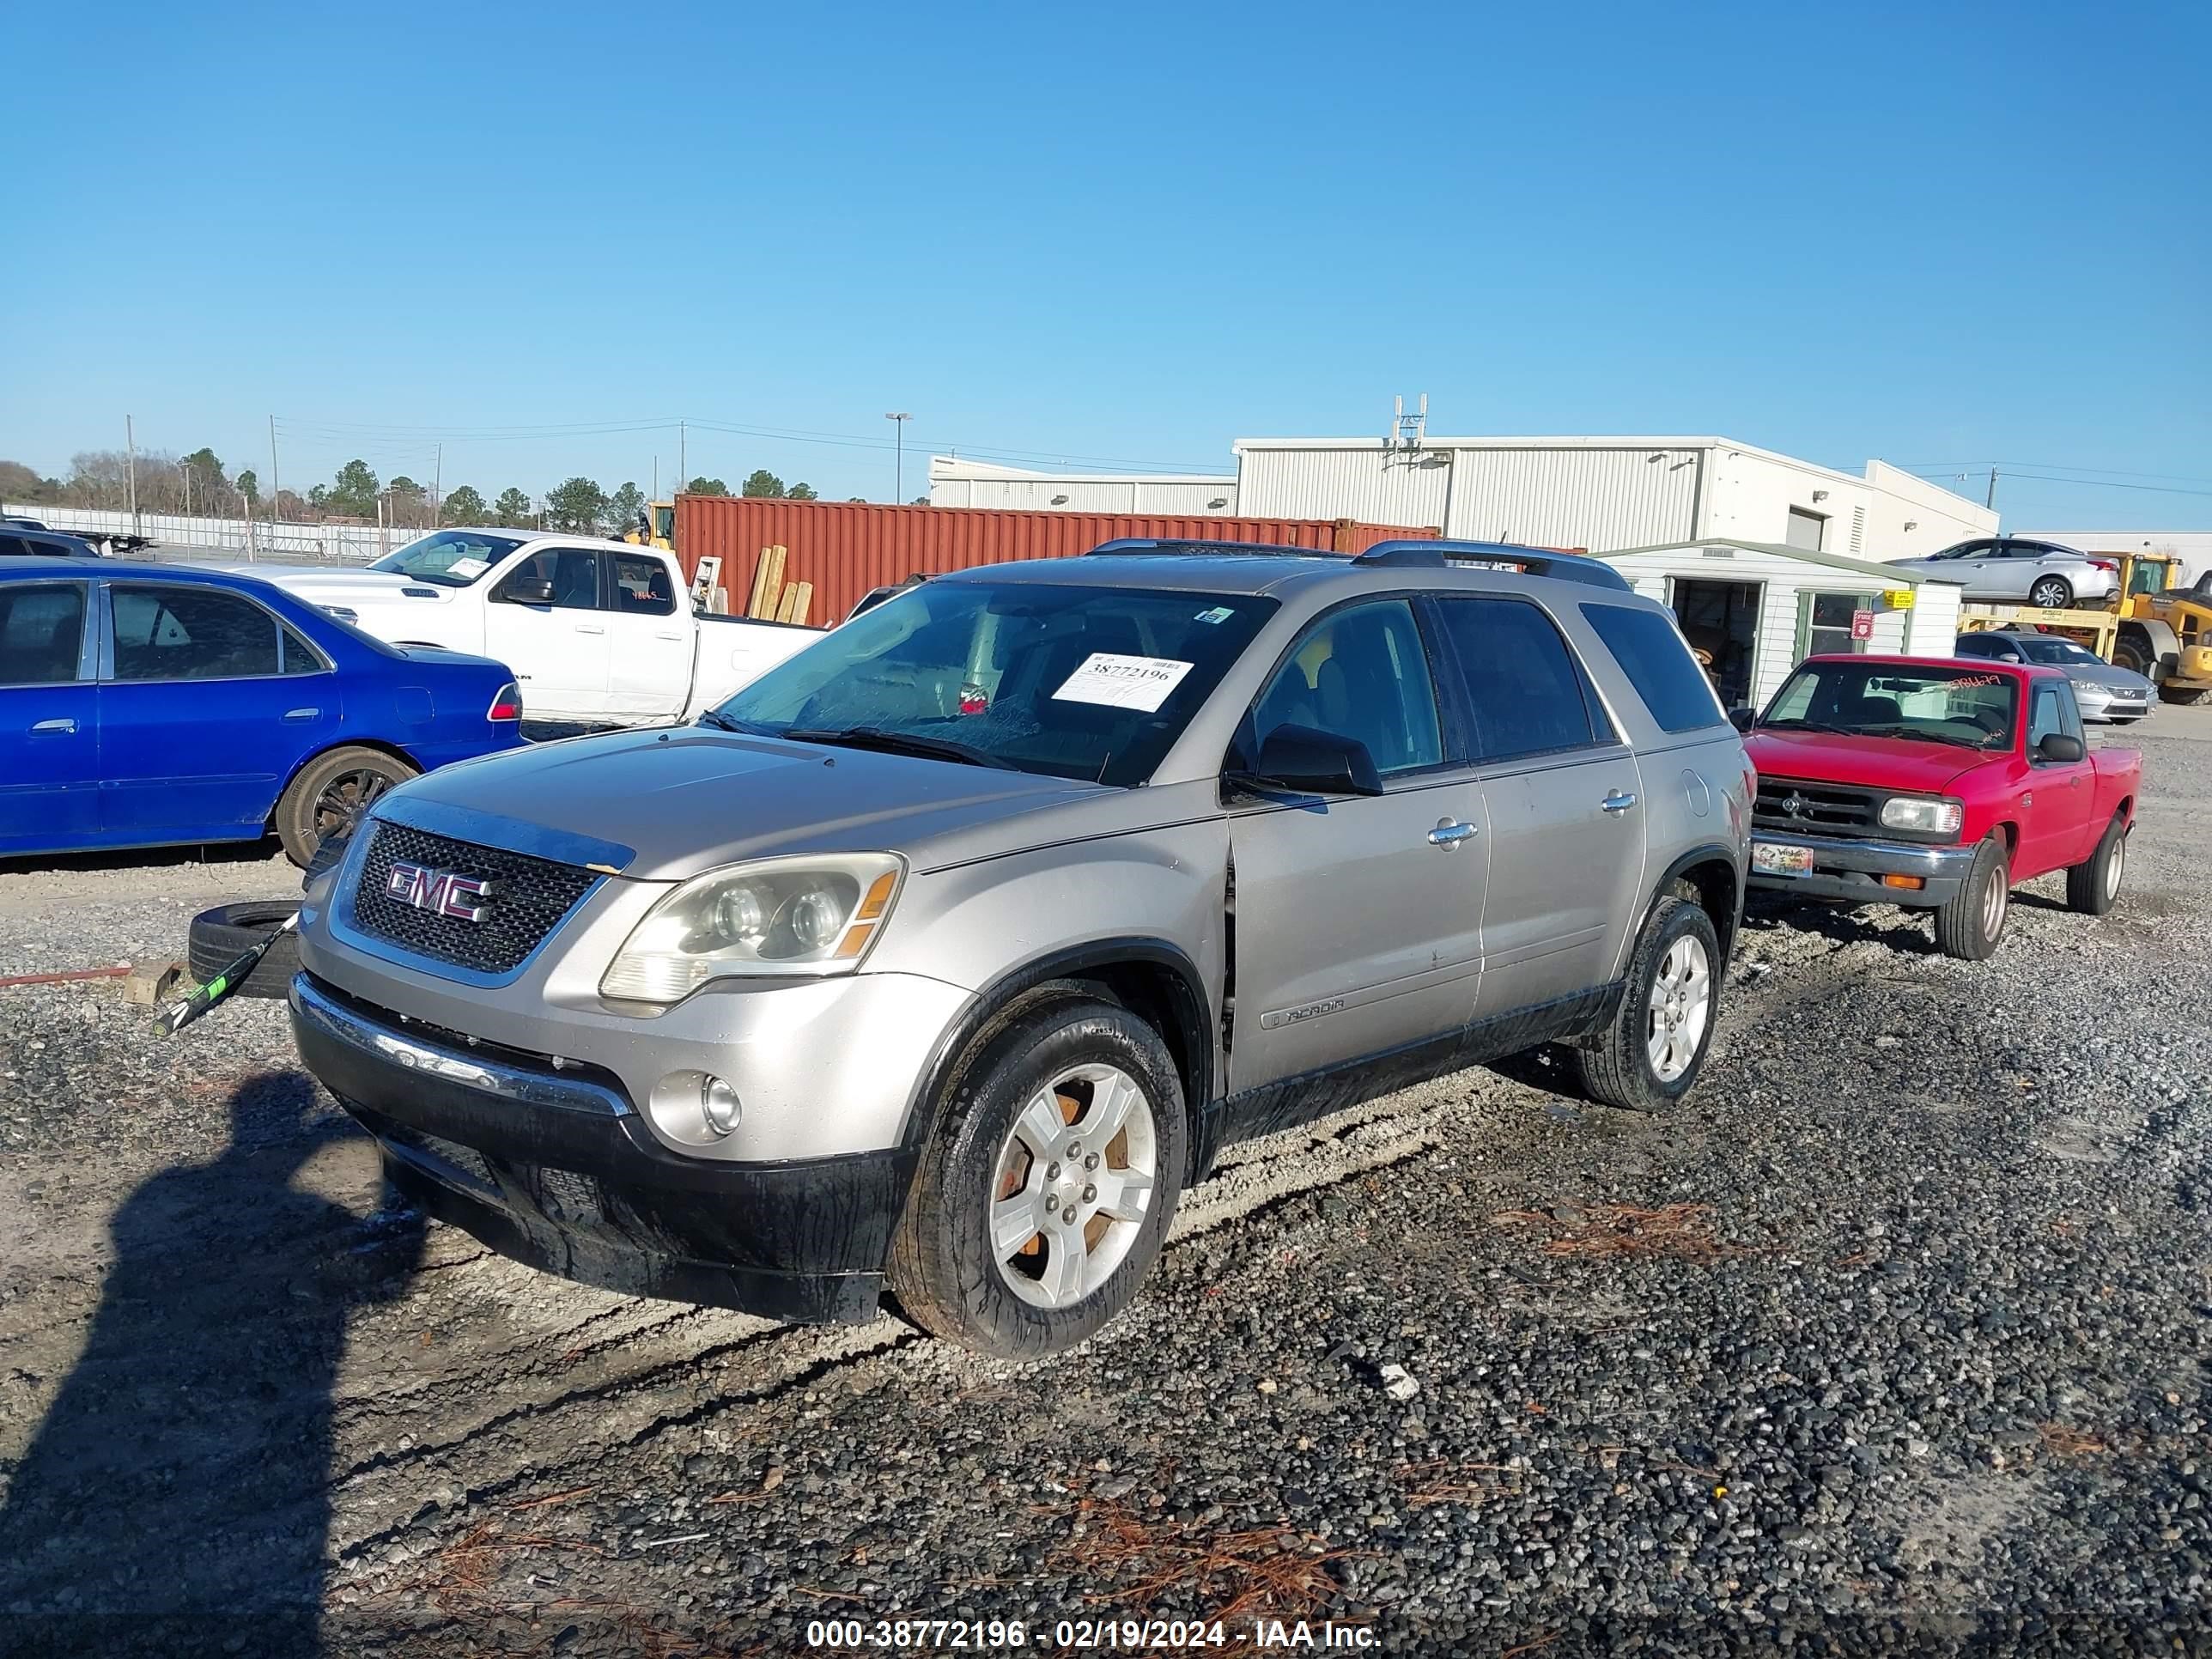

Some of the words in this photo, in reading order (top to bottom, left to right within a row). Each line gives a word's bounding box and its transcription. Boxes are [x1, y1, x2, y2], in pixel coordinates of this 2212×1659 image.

[1087, 664, 1173, 681] 38772196
[386, 862, 492, 922] GMC
[1286, 1000, 1345, 1022] ACADIA
